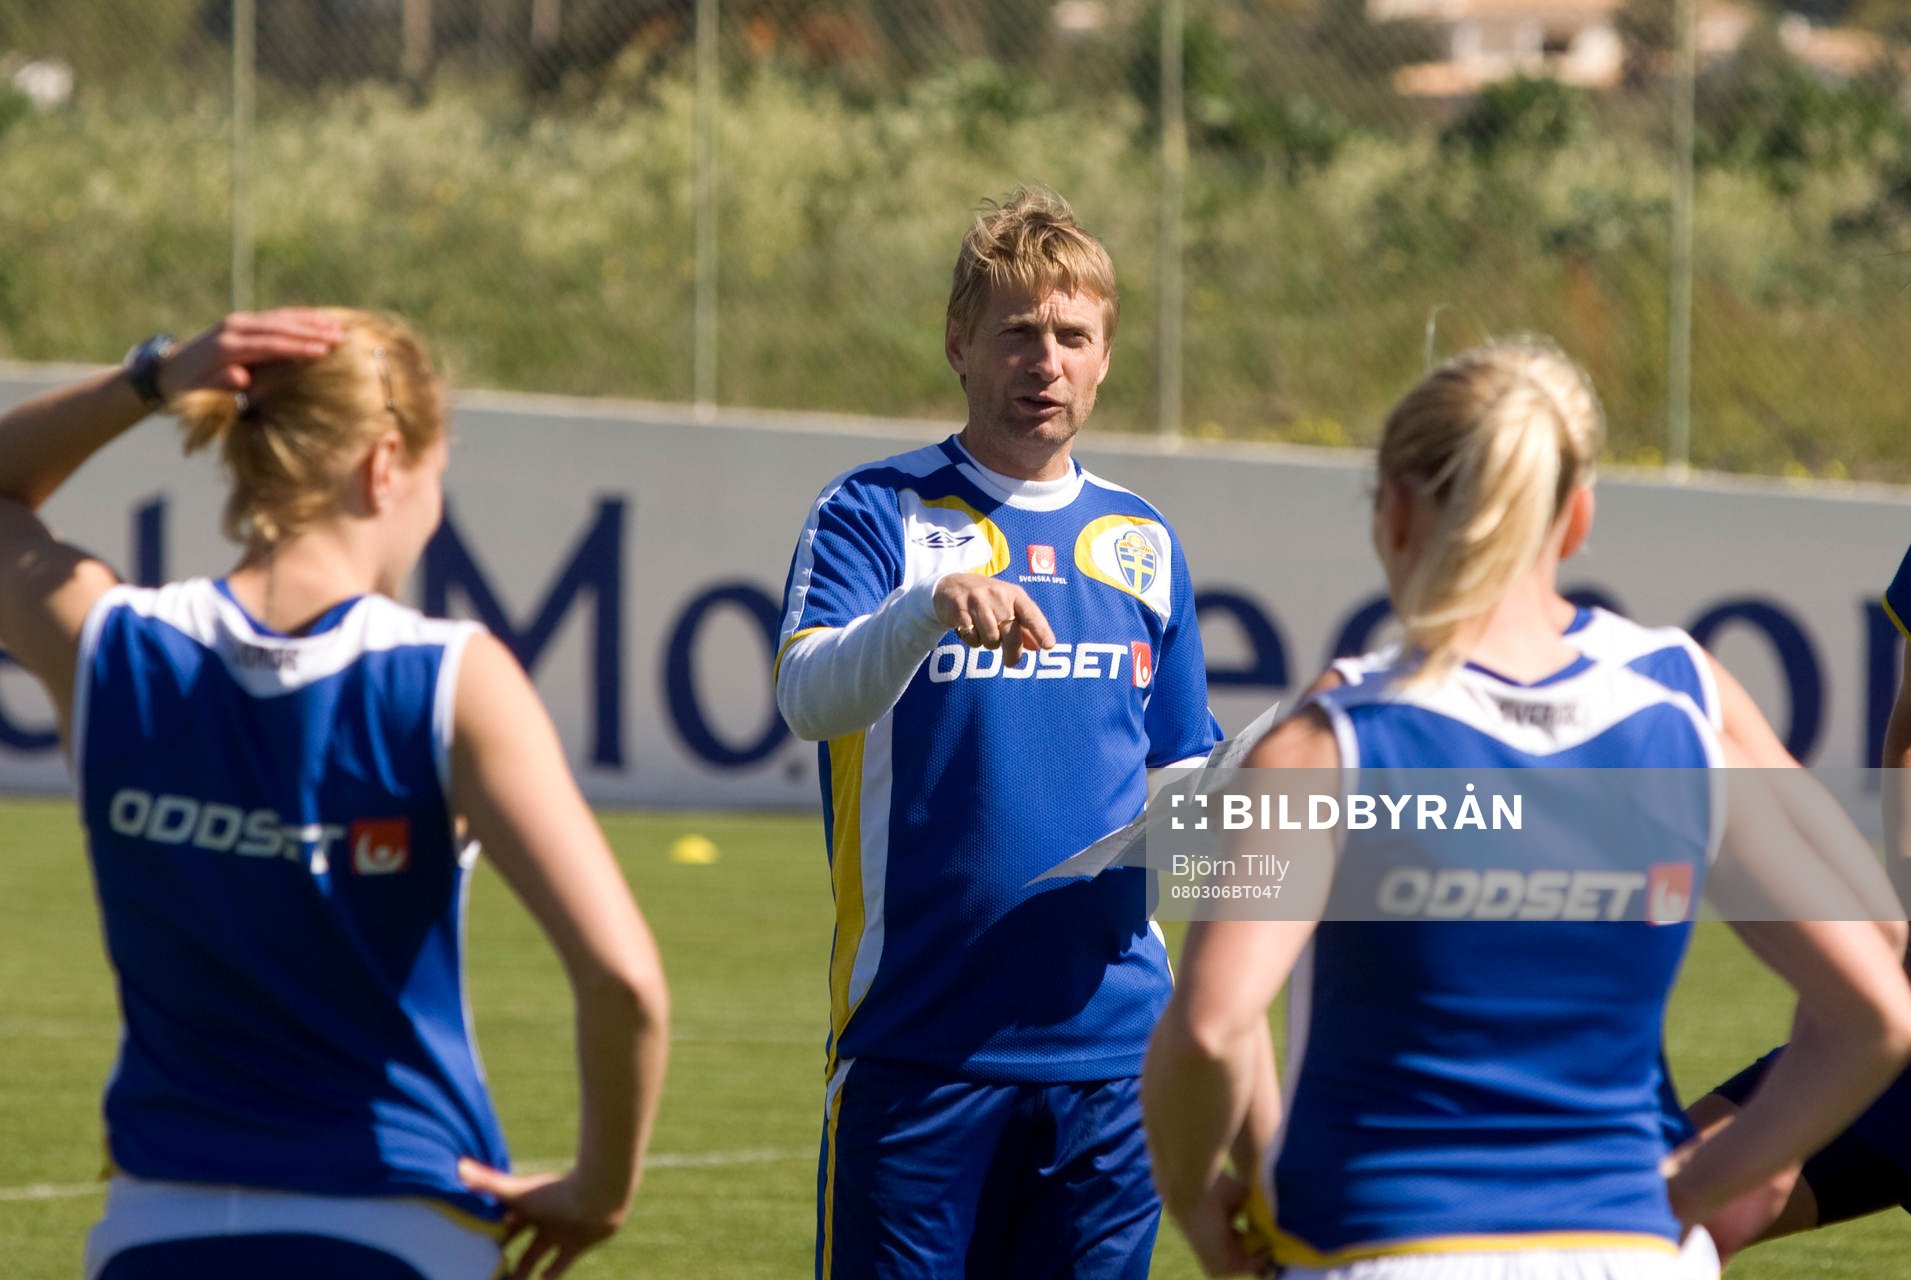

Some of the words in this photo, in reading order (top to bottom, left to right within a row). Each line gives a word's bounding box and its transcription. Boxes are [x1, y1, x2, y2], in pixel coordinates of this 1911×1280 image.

[1019, 575, 1050, 583] SVENSKA
[1052, 576, 1068, 584] SPEL
[1378, 866, 1646, 920] ODDSET
